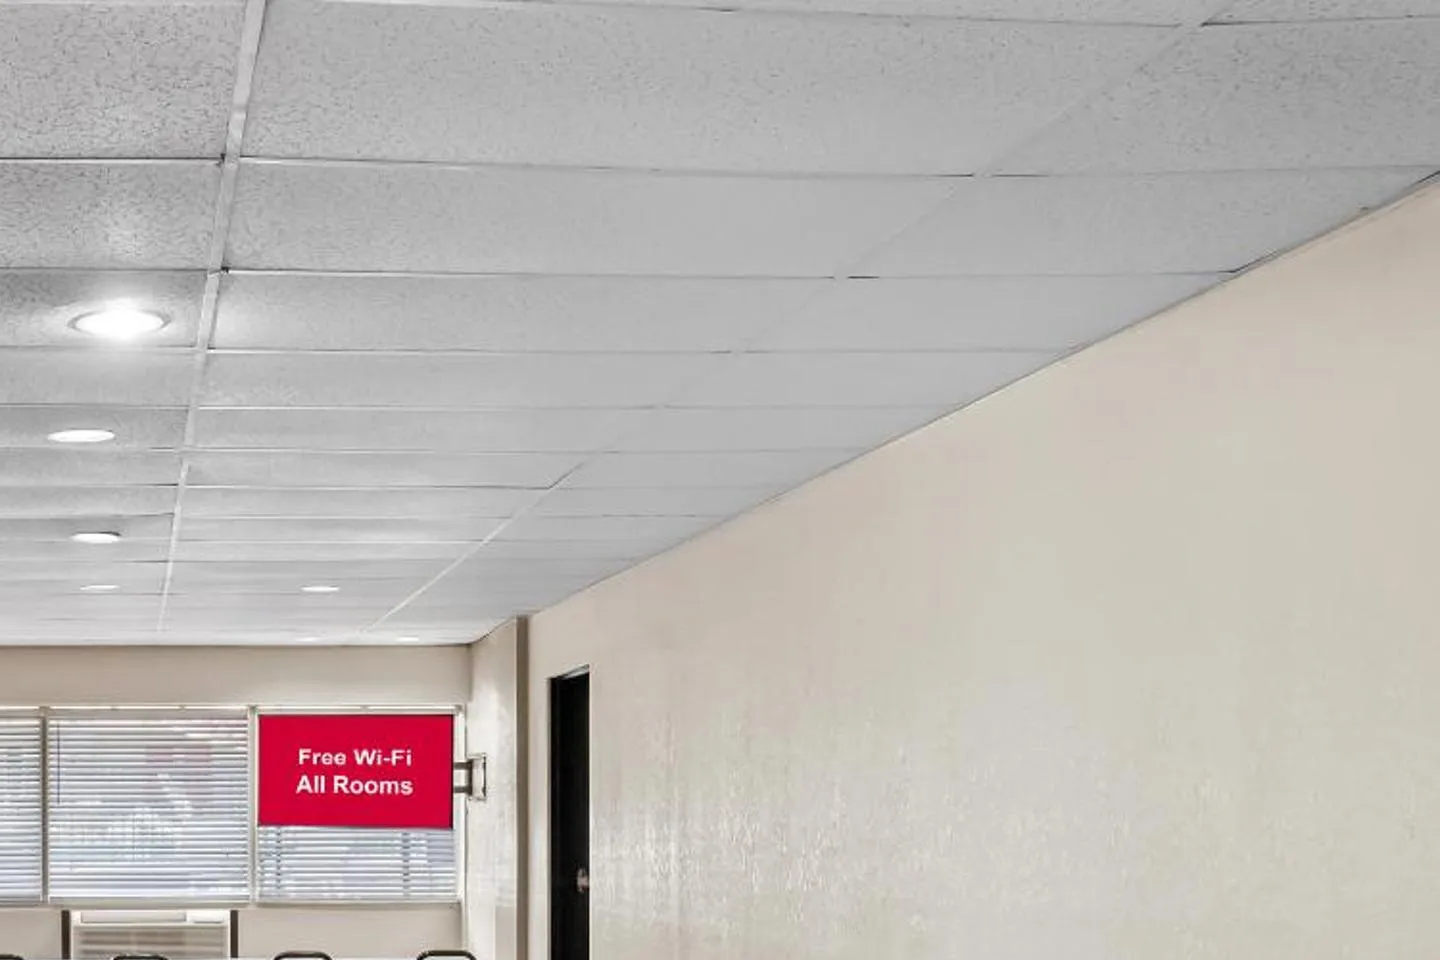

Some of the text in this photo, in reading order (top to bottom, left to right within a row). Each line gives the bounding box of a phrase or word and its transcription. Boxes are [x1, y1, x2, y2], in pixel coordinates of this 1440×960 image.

[298, 748, 412, 766] Free Wi-Fi
[295, 775, 414, 796] All Rooms
